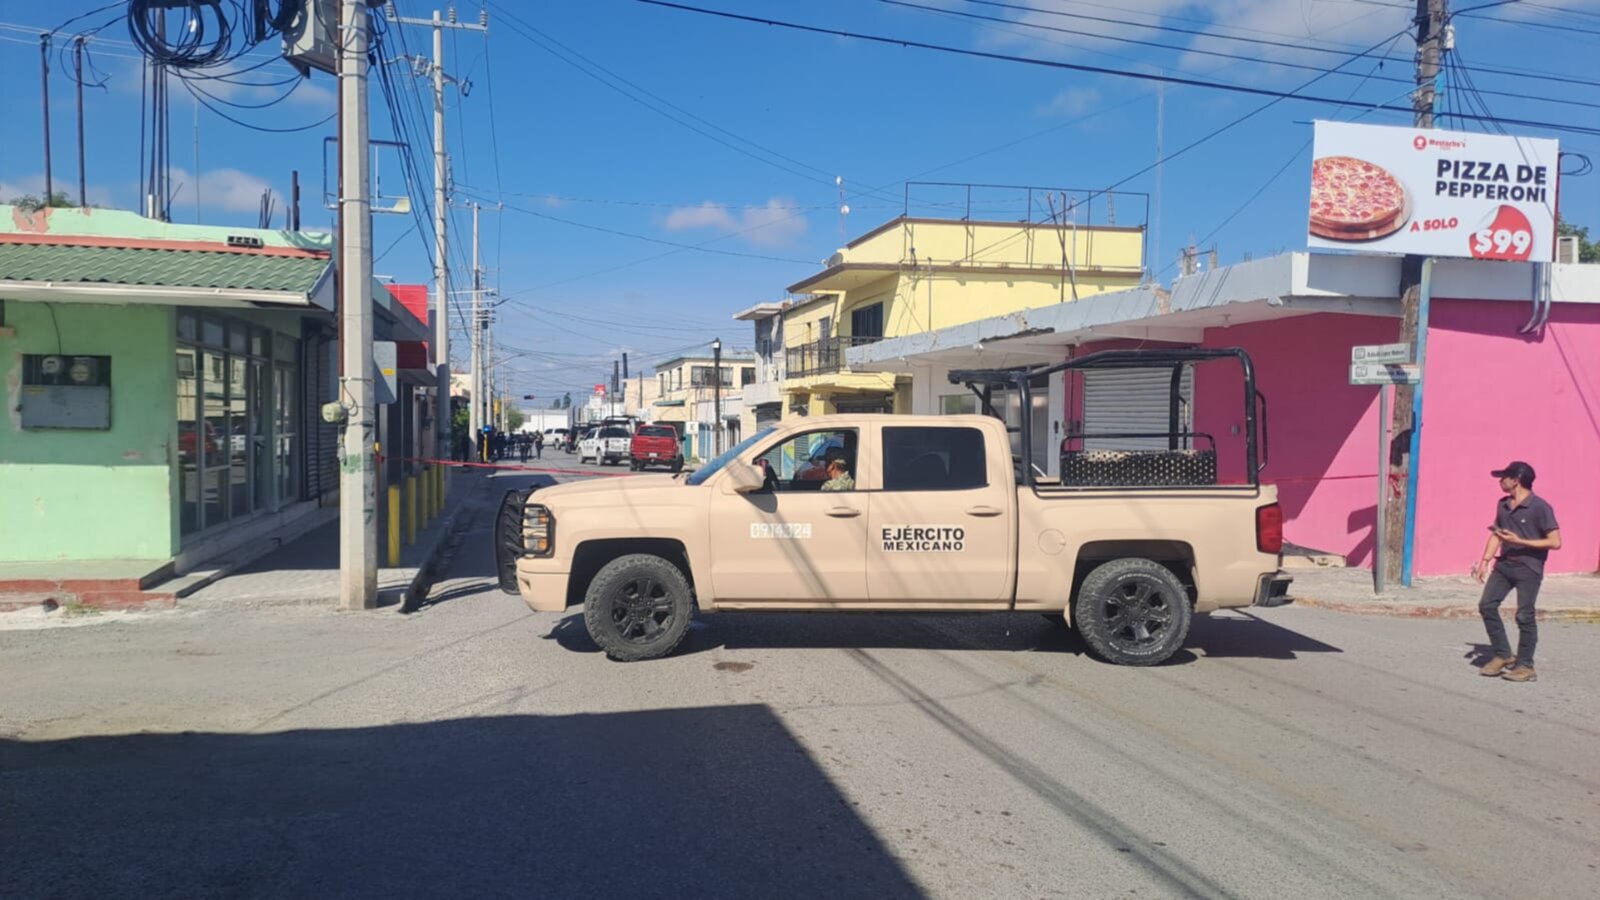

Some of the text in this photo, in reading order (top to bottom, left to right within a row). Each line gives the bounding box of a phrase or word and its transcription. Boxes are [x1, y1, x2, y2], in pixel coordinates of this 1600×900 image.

[1437, 159, 1547, 185] PIZZA DE
[1435, 181, 1546, 202] PEPPERONI
[1410, 217, 1458, 232] A SOLO
[1474, 228, 1532, 255] $99
[882, 525, 965, 541] EJÉRCITO
[883, 541, 963, 551] MEXICANO
